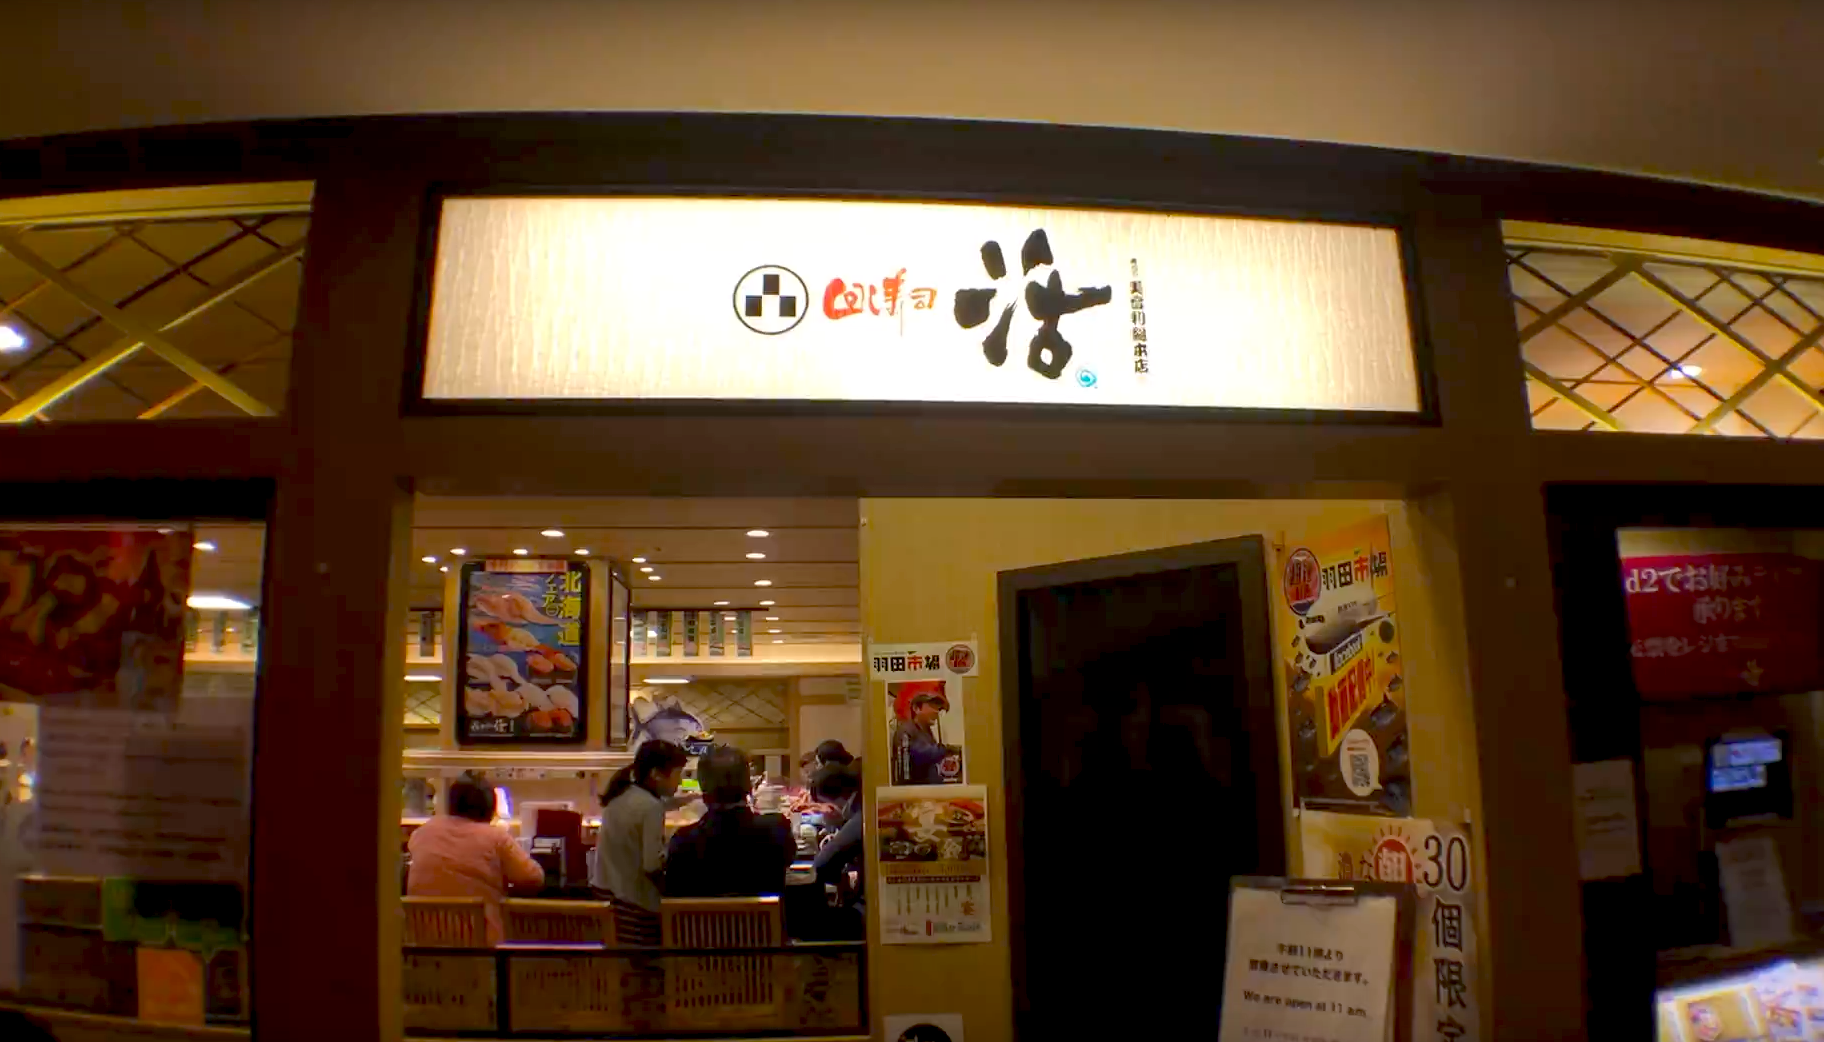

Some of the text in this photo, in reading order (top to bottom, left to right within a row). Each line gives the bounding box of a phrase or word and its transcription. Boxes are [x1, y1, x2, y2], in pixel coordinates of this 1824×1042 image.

[953, 228, 1112, 380] 活
[1321, 551, 1388, 590] 羽田市場
[557, 570, 582, 645] 北海道
[873, 654, 940, 673] 羽田市場
